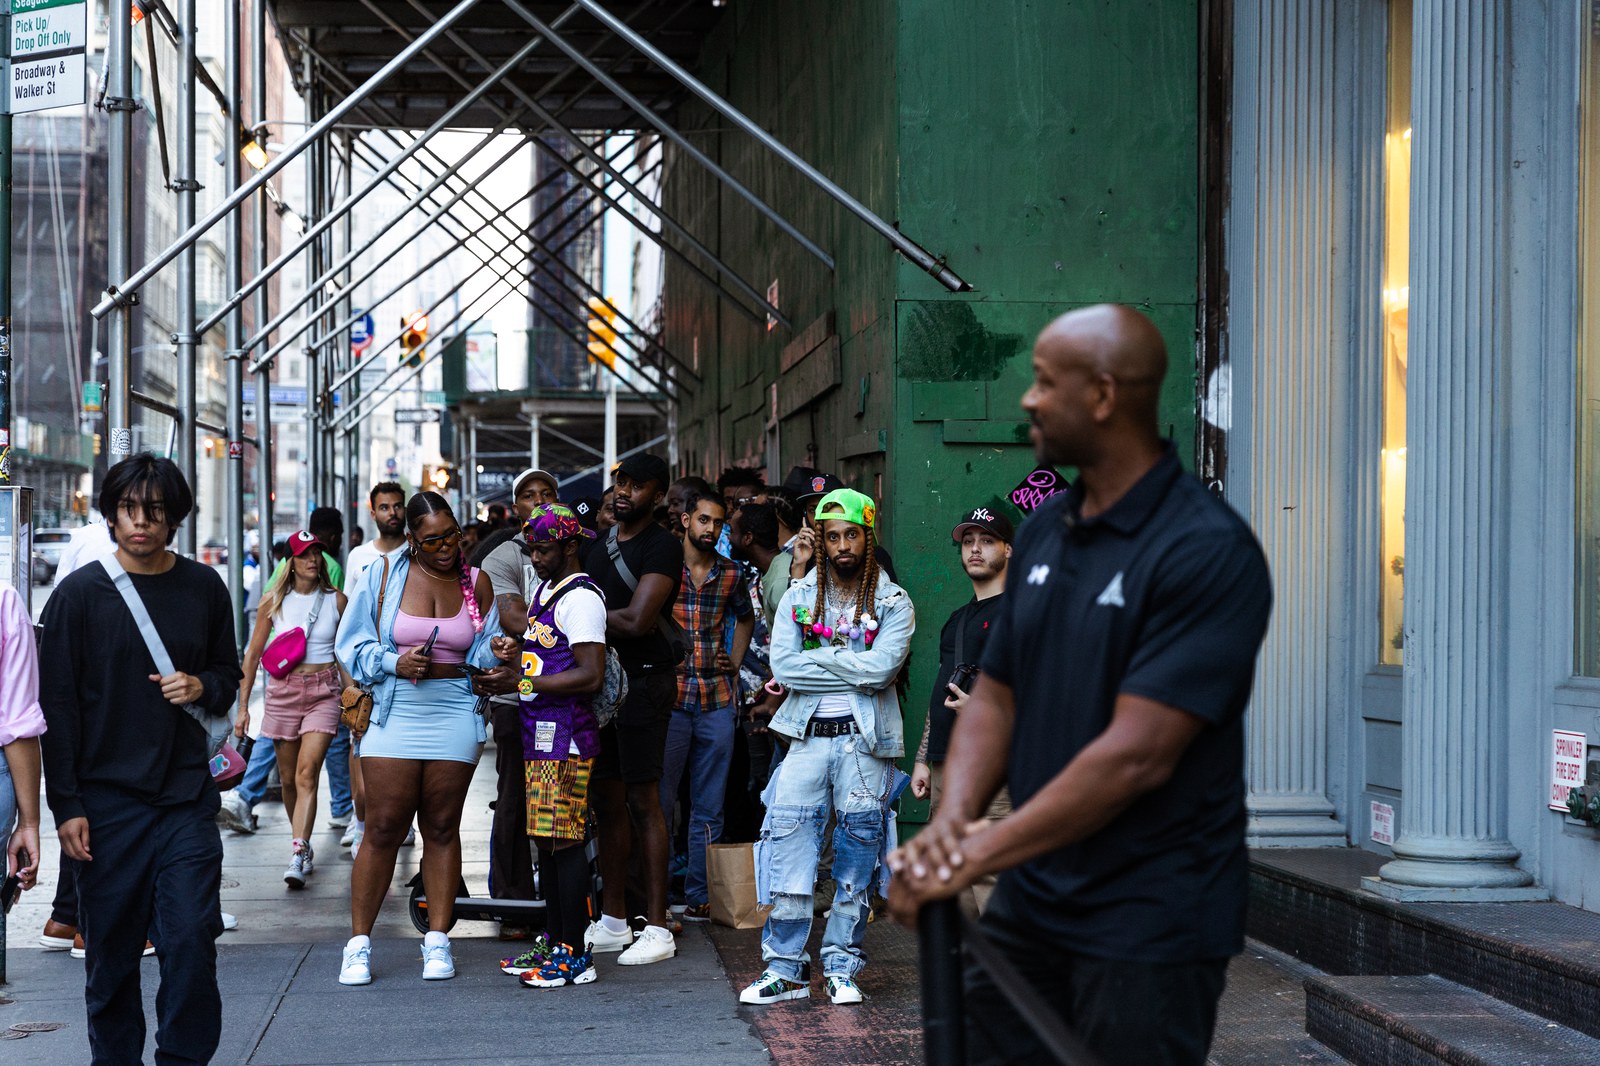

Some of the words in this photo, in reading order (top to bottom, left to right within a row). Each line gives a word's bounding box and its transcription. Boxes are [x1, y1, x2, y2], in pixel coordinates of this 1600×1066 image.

[16, 19, 33, 33] Pick
[36, 14, 51, 32] Up/
[15, 37, 35, 51] Drop
[38, 32, 50, 47] Off
[52, 30, 71, 46] Only
[15, 64, 56, 80] Broadway
[59, 61, 65, 74] &
[15, 83, 45, 99] Walker
[47, 81, 56, 95] St
[971, 508, 989, 520] NY
[1556, 739, 1582, 758] SPRINKLER
[1556, 761, 1567, 779] FIRE
[1553, 784, 1572, 801] CONNE
